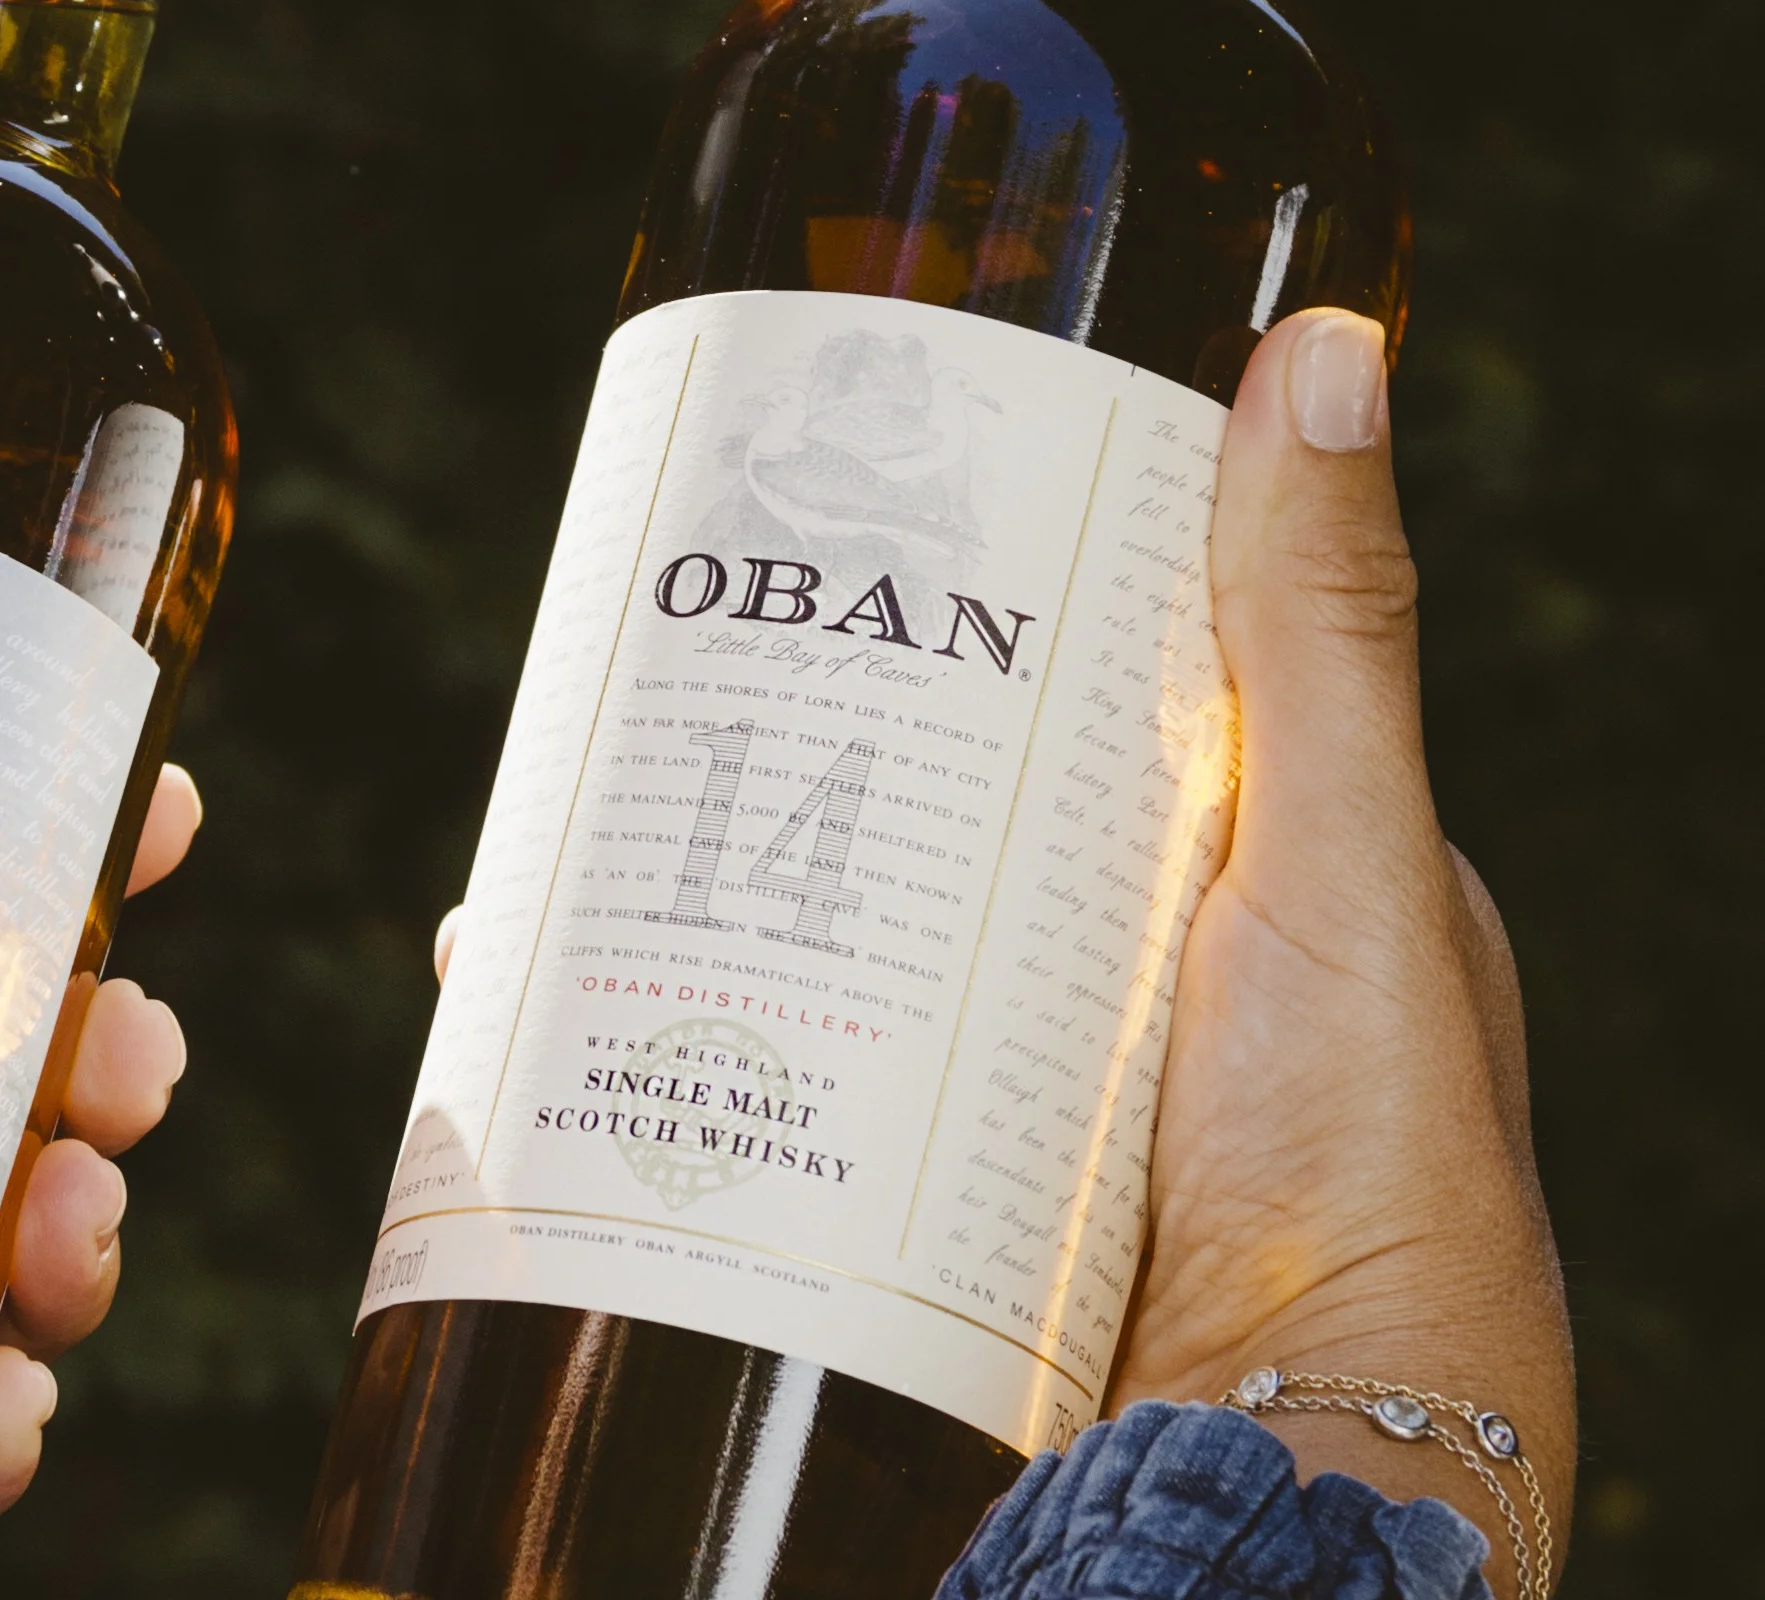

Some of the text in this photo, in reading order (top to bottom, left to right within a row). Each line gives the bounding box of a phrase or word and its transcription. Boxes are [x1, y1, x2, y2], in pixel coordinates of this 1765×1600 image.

[1120, 538, 1202, 585] overlordship
[764, 638, 820, 674] Bay
[825, 649, 870, 679] of
[682, 681, 710, 692] THE
[715, 684, 769, 699] SHORES
[778, 691, 798, 702] OF
[805, 696, 846, 711] LORN
[854, 704, 886, 720] LIES
[894, 716, 904, 725] A
[913, 718, 975, 745] RECORD
[982, 738, 1004, 753] OF
[610, 754, 623, 767] IN
[630, 755, 659, 767] THE
[712, 760, 742, 773] THE
[749, 764, 793, 781] FIRST
[798, 773, 877, 799] SETTLERS
[882, 792, 954, 820] ARRIVED
[960, 814, 983, 828] ON
[621, 718, 993, 791] MAN FAR MORE ANCIENT THAN THAT OF ANY CITY
[600, 793, 625, 804] THE
[630, 794, 706, 809] MAINLAND
[712, 799, 732, 811] IN
[736, 804, 780, 820] 5,000
[816, 818, 851, 834] AND
[858, 827, 947, 860] SHELTERED
[954, 853, 973, 868] IN
[642, 718, 875, 959] 14
[590, 832, 964, 906] THE NATURAL CAVES OF THE LAND THEN KNOWN
[580, 870, 595, 880] AS
[674, 874, 703, 889] THE
[880, 914, 910, 932] WAS
[920, 926, 954, 946] ONE
[570, 906, 601, 918] SUCH
[606, 908, 661, 922] SHELTER
[668, 914, 723, 929] HIDDEN
[730, 922, 748, 933] IN
[756, 927, 785, 943] THE
[867, 952, 944, 984] BHARRAIN
[560, 946, 934, 1023] CLIFFS WHICH RISE DRAMATICALLY ABOVE THE
[586, 1036, 837, 1093] WEST HIGHLAND
[993, 1036, 1082, 1082] precipitous
[584, 1067, 819, 1130] SINGLE MALT
[535, 1106, 681, 1144] SCOTCH
[698, 1126, 856, 1184] WHISKY
[510, 1224, 831, 1293] OBAN DISTILLERY OBAN ARGYLL SCOTLAND
